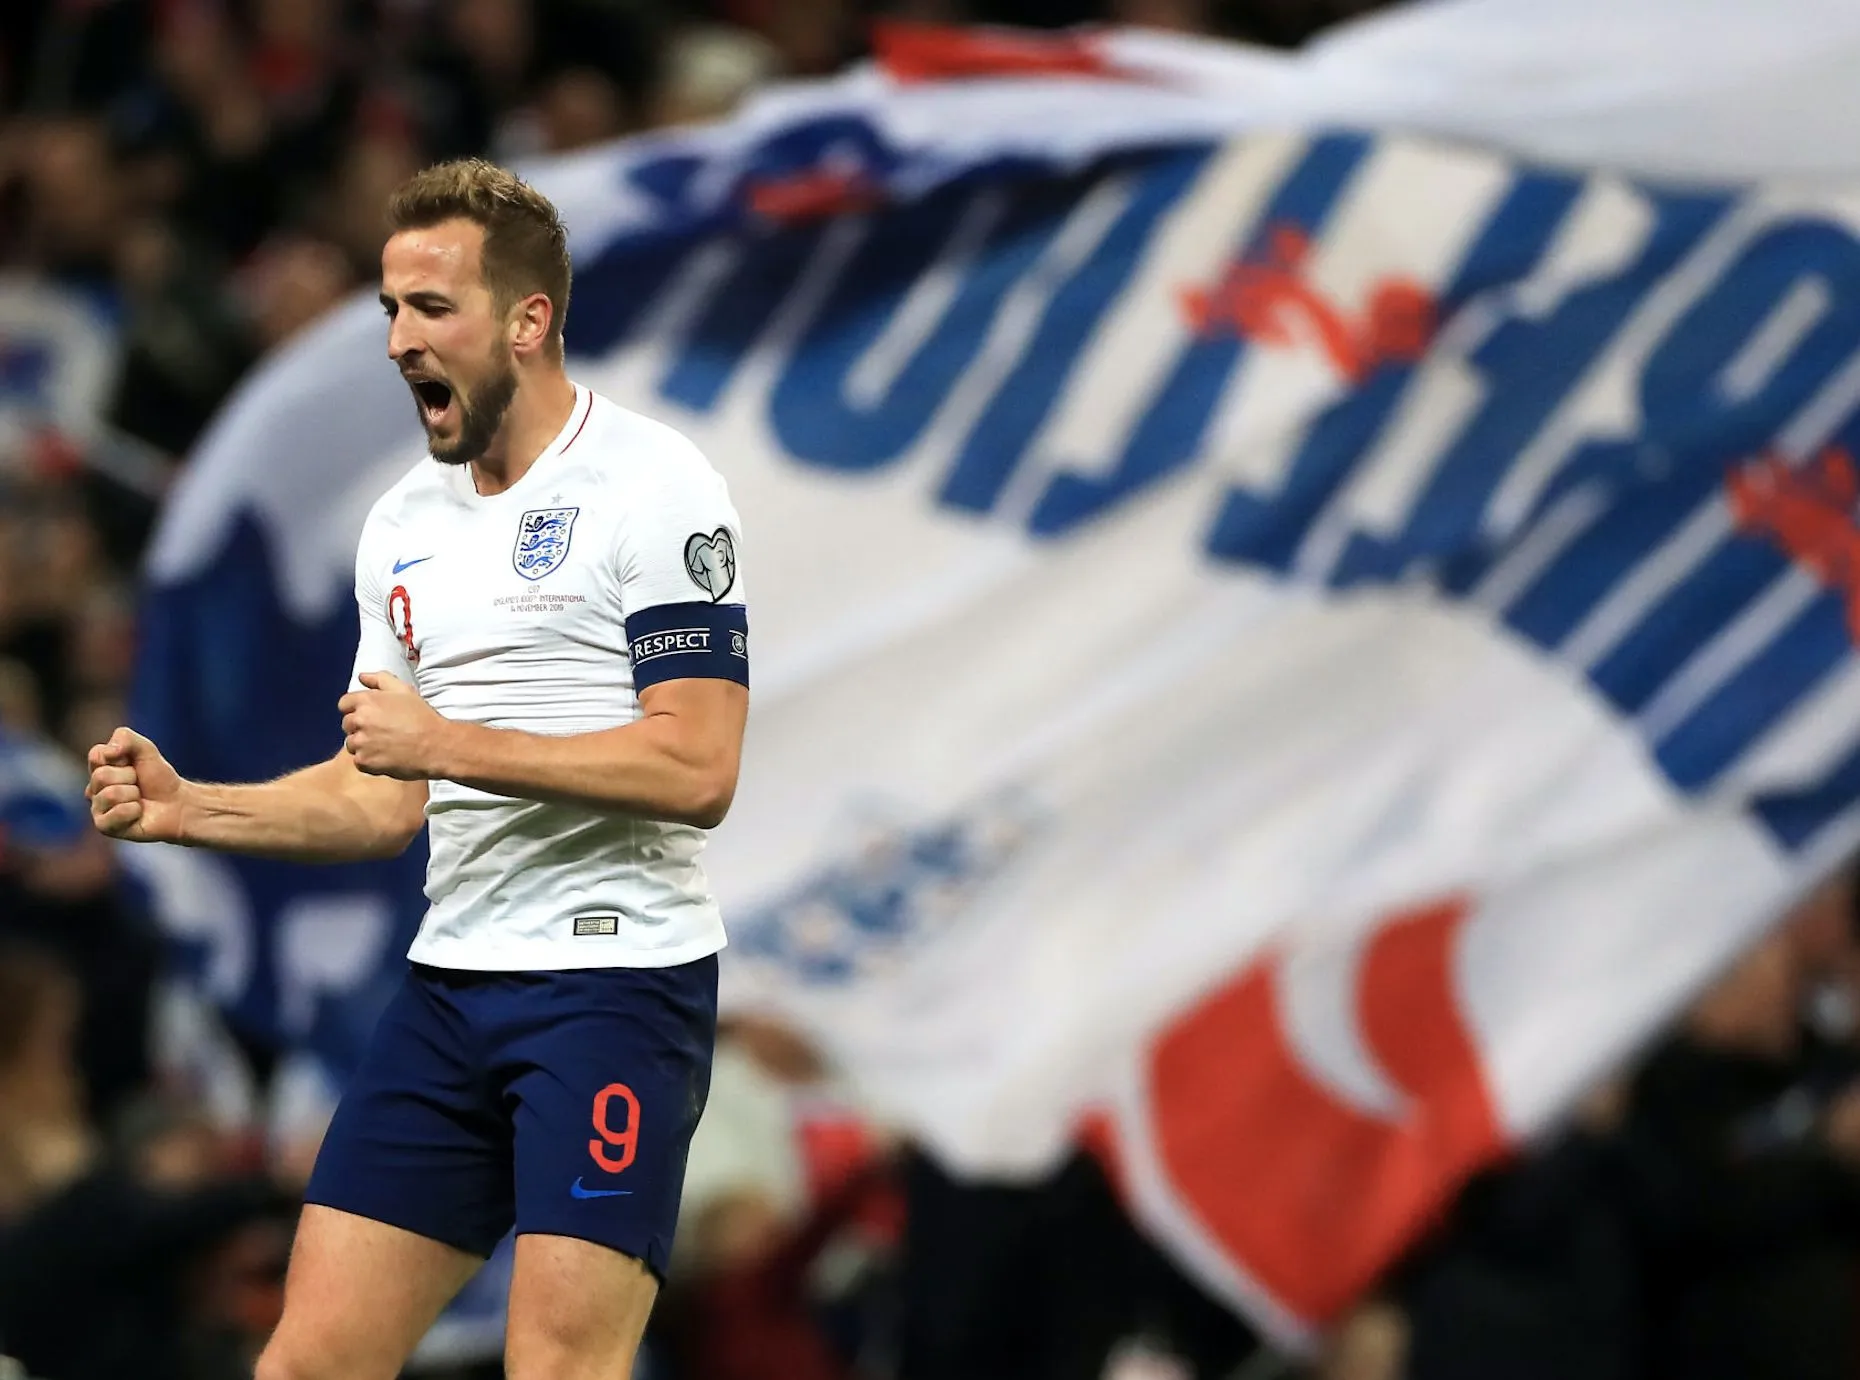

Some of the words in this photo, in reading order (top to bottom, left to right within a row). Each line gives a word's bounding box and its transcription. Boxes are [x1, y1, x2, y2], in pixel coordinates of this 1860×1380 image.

[517, 604, 547, 612] NOVEMBER
[634, 633, 711, 659] RESPECT
[589, 1083, 641, 1174] 9
